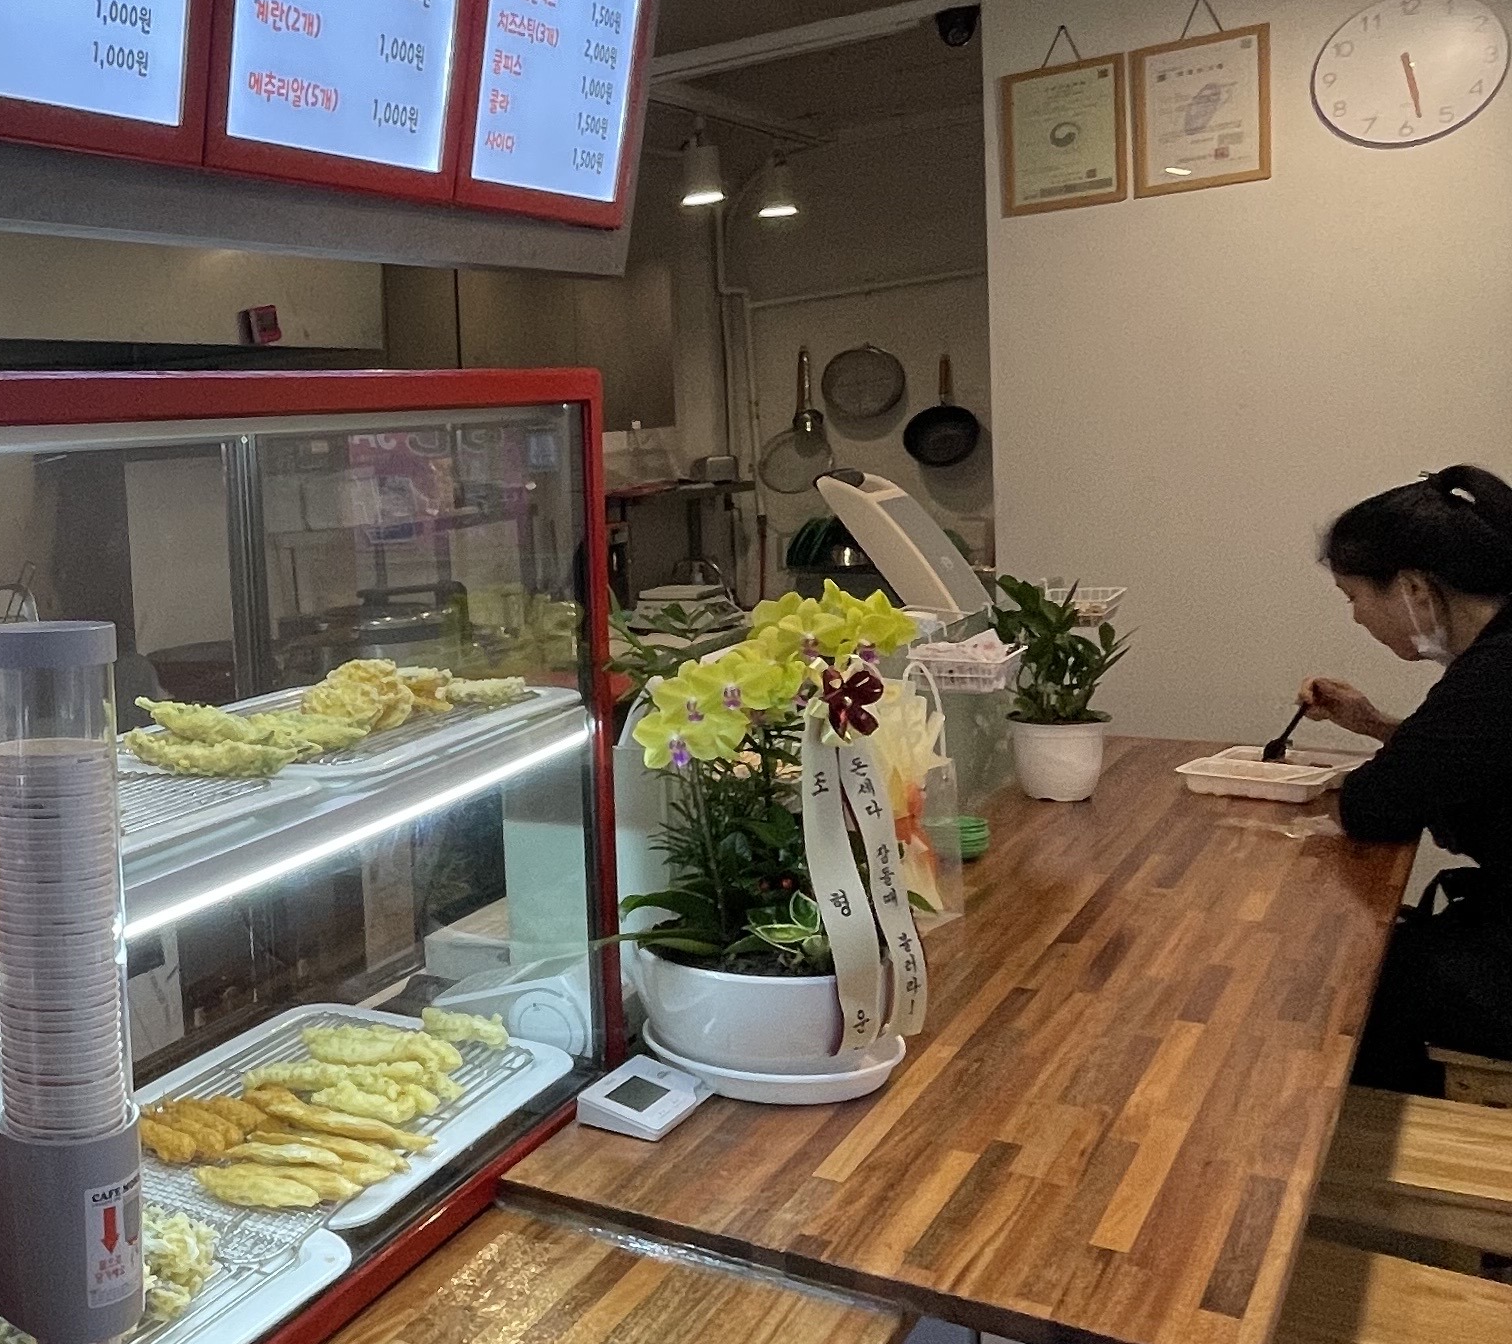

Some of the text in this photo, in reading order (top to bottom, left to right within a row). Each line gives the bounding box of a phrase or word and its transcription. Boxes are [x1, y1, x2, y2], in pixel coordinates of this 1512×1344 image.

[92, 42, 149, 77] 1,000원
[380, 34, 426, 72] 1,000원
[584, 39, 618, 70] 2,000원
[581, 75, 613, 105] 1,000원
[1322, 72, 1337, 88] 9
[373, 99, 419, 134] 1,000원
[1362, 115, 1378, 134] 7
[1398, 120, 1415, 137] 6
